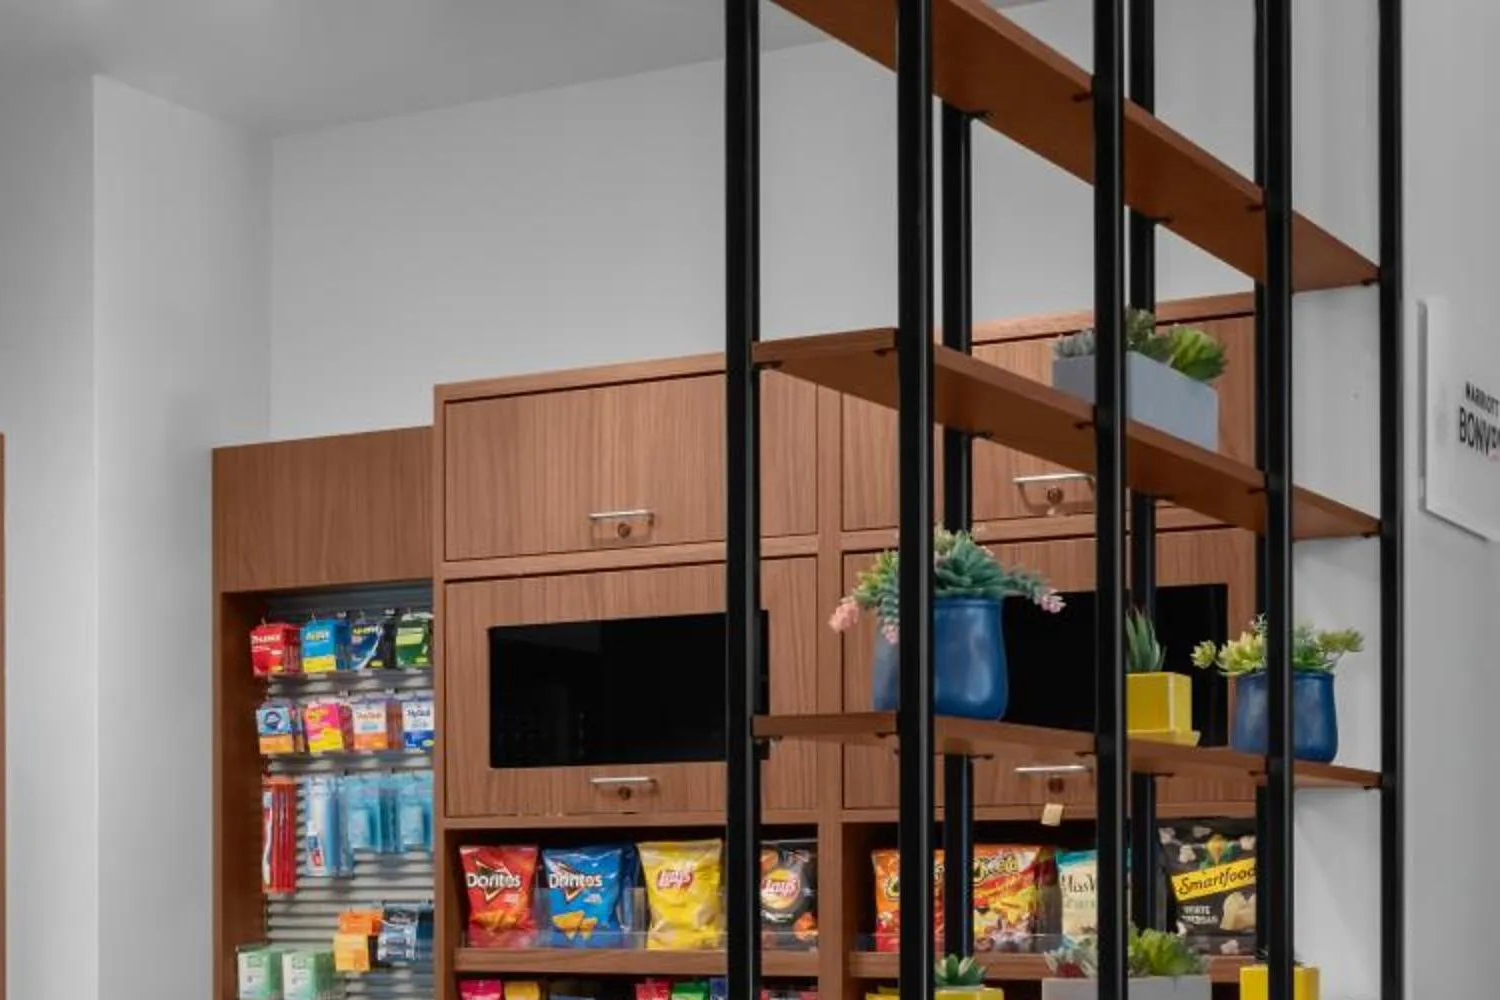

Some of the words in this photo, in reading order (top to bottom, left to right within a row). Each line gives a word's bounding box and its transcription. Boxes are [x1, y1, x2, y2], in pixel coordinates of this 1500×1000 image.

[1465, 382, 1499, 417] MARRIOTT
[1459, 405, 1500, 456] BONVO
[466, 871, 521, 888] Doritos
[549, 873, 604, 889] Doritos
